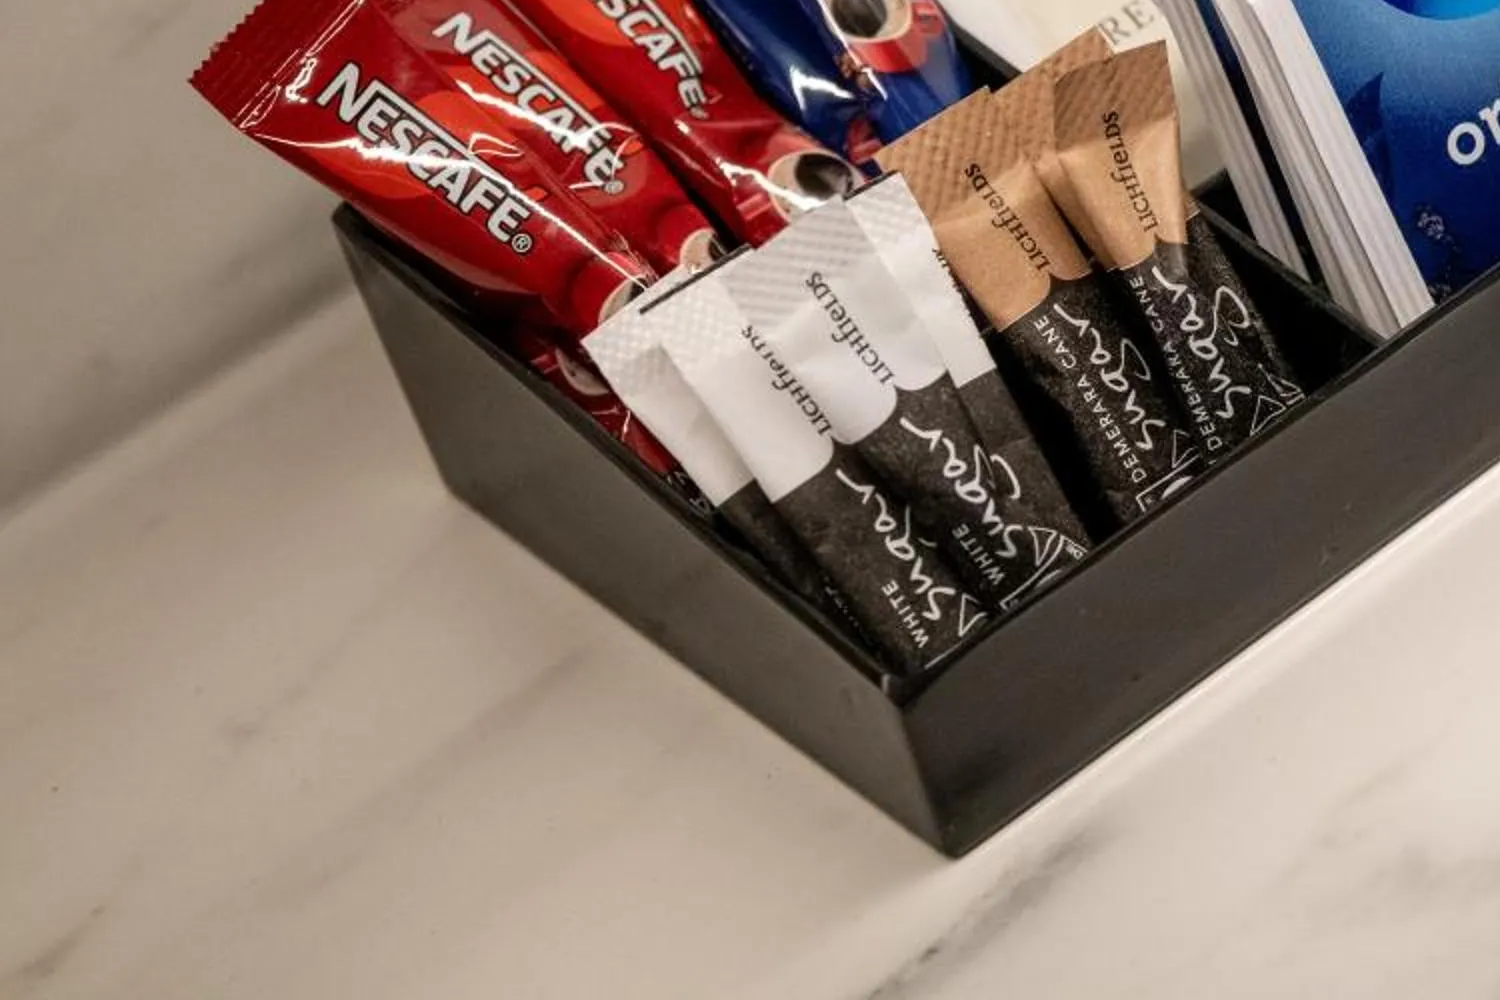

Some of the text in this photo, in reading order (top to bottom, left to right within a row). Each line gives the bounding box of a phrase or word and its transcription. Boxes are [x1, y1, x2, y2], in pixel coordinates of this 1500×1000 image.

[1032, 314, 1147, 483] DEMERARA CANE
[1129, 276, 1223, 451] DEMERARA CANE
[952, 523, 1006, 586] WHITE
[881, 580, 930, 649] WHITE
